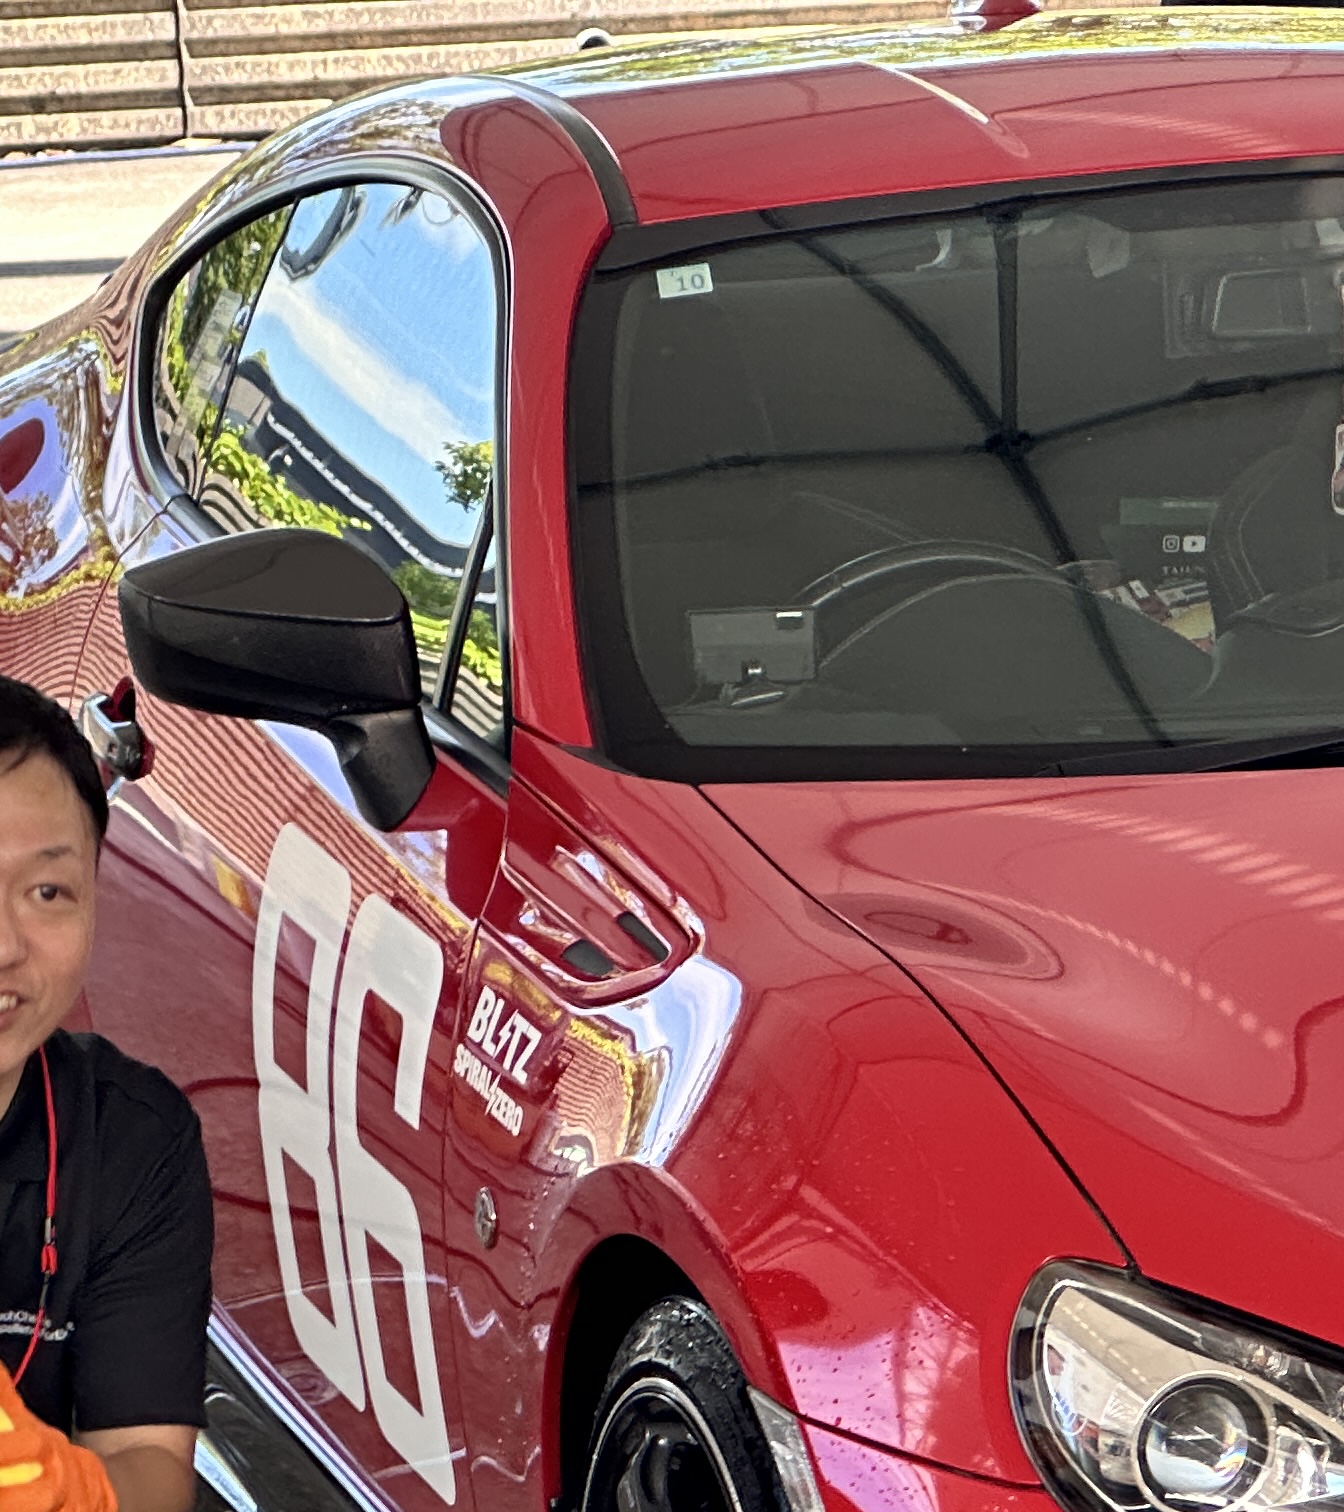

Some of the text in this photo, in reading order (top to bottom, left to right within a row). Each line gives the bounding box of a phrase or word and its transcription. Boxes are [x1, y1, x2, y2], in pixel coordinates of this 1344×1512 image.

[676, 273, 706, 291] 10
[466, 983, 543, 1086] BLITZ
[252, 820, 457, 1507] 86
